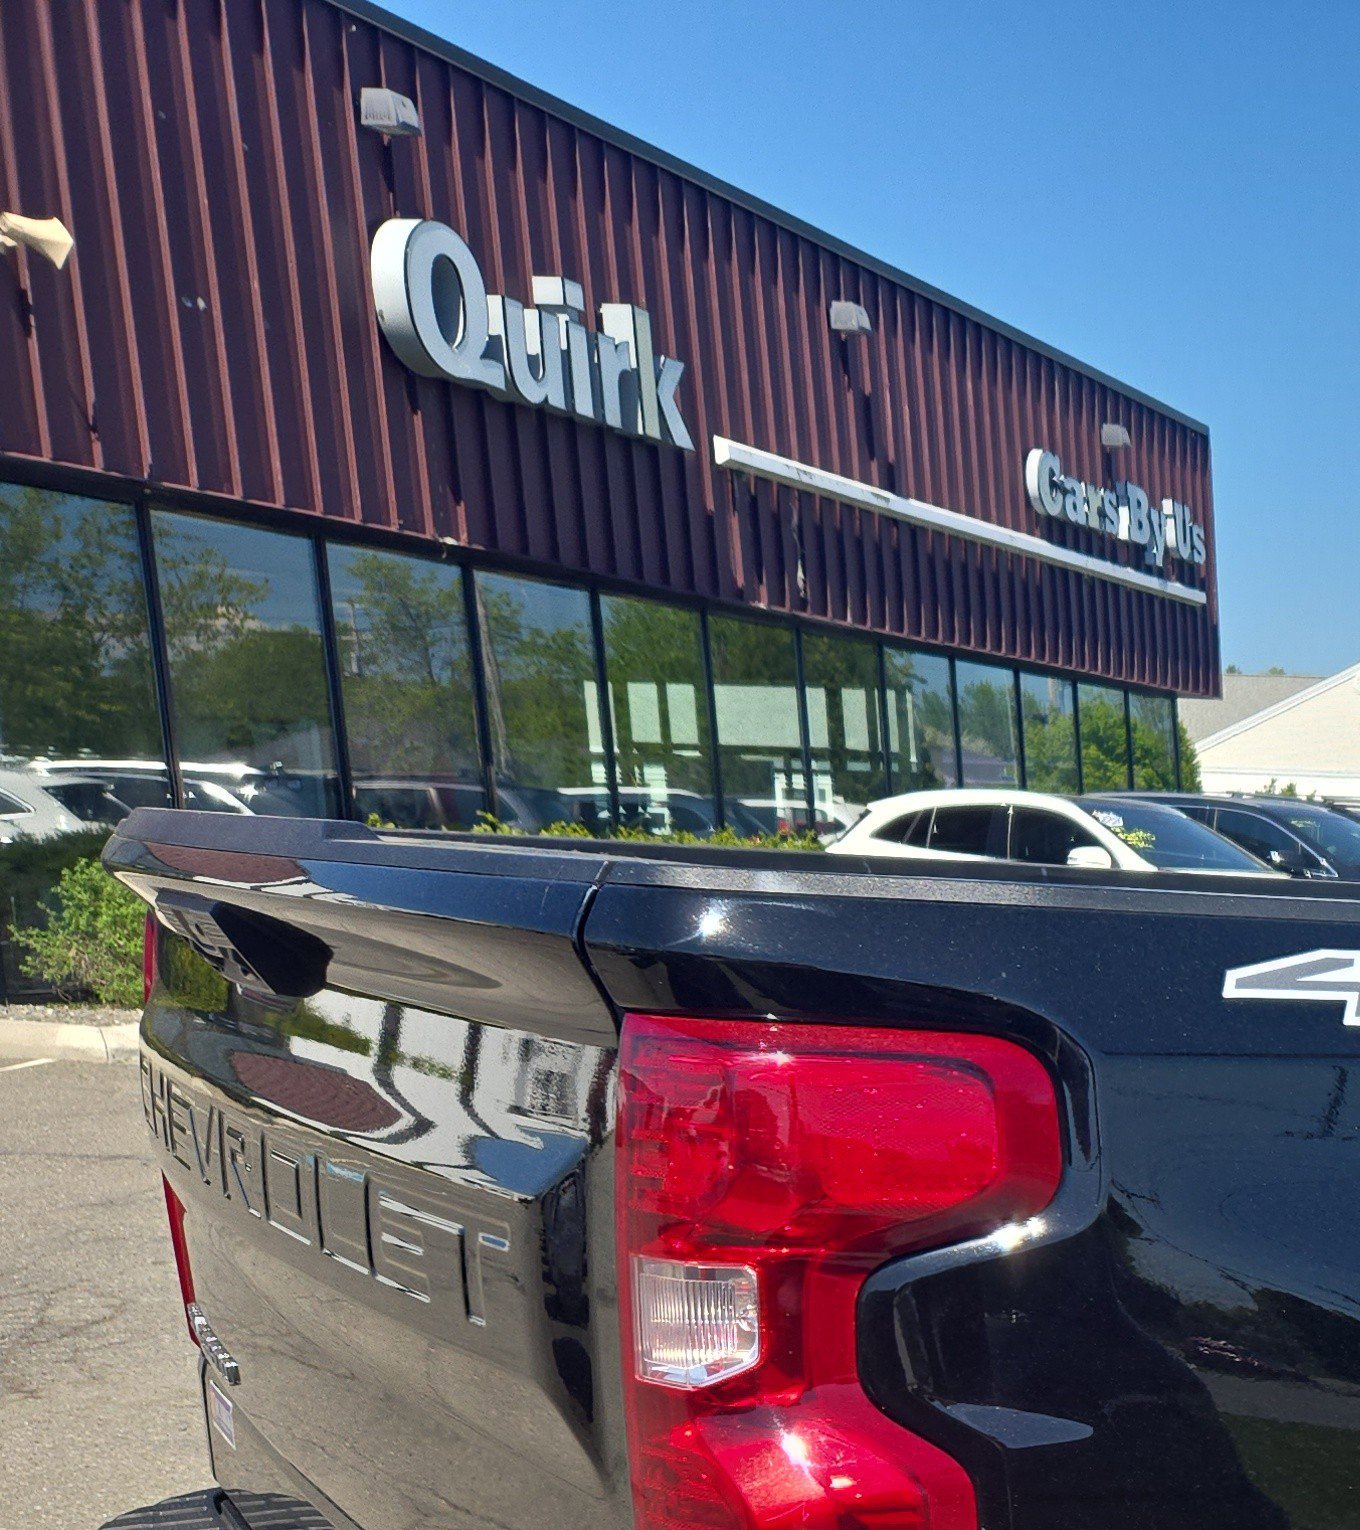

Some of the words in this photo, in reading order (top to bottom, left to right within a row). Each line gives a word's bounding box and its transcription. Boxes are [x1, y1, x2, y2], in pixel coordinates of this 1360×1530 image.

[371, 218, 696, 452] Quirk
[1026, 448, 1120, 537] Cars
[1117, 480, 1167, 567] By
[1161, 498, 1207, 565] Us
[139, 1045, 512, 1328] CHEVROLET
